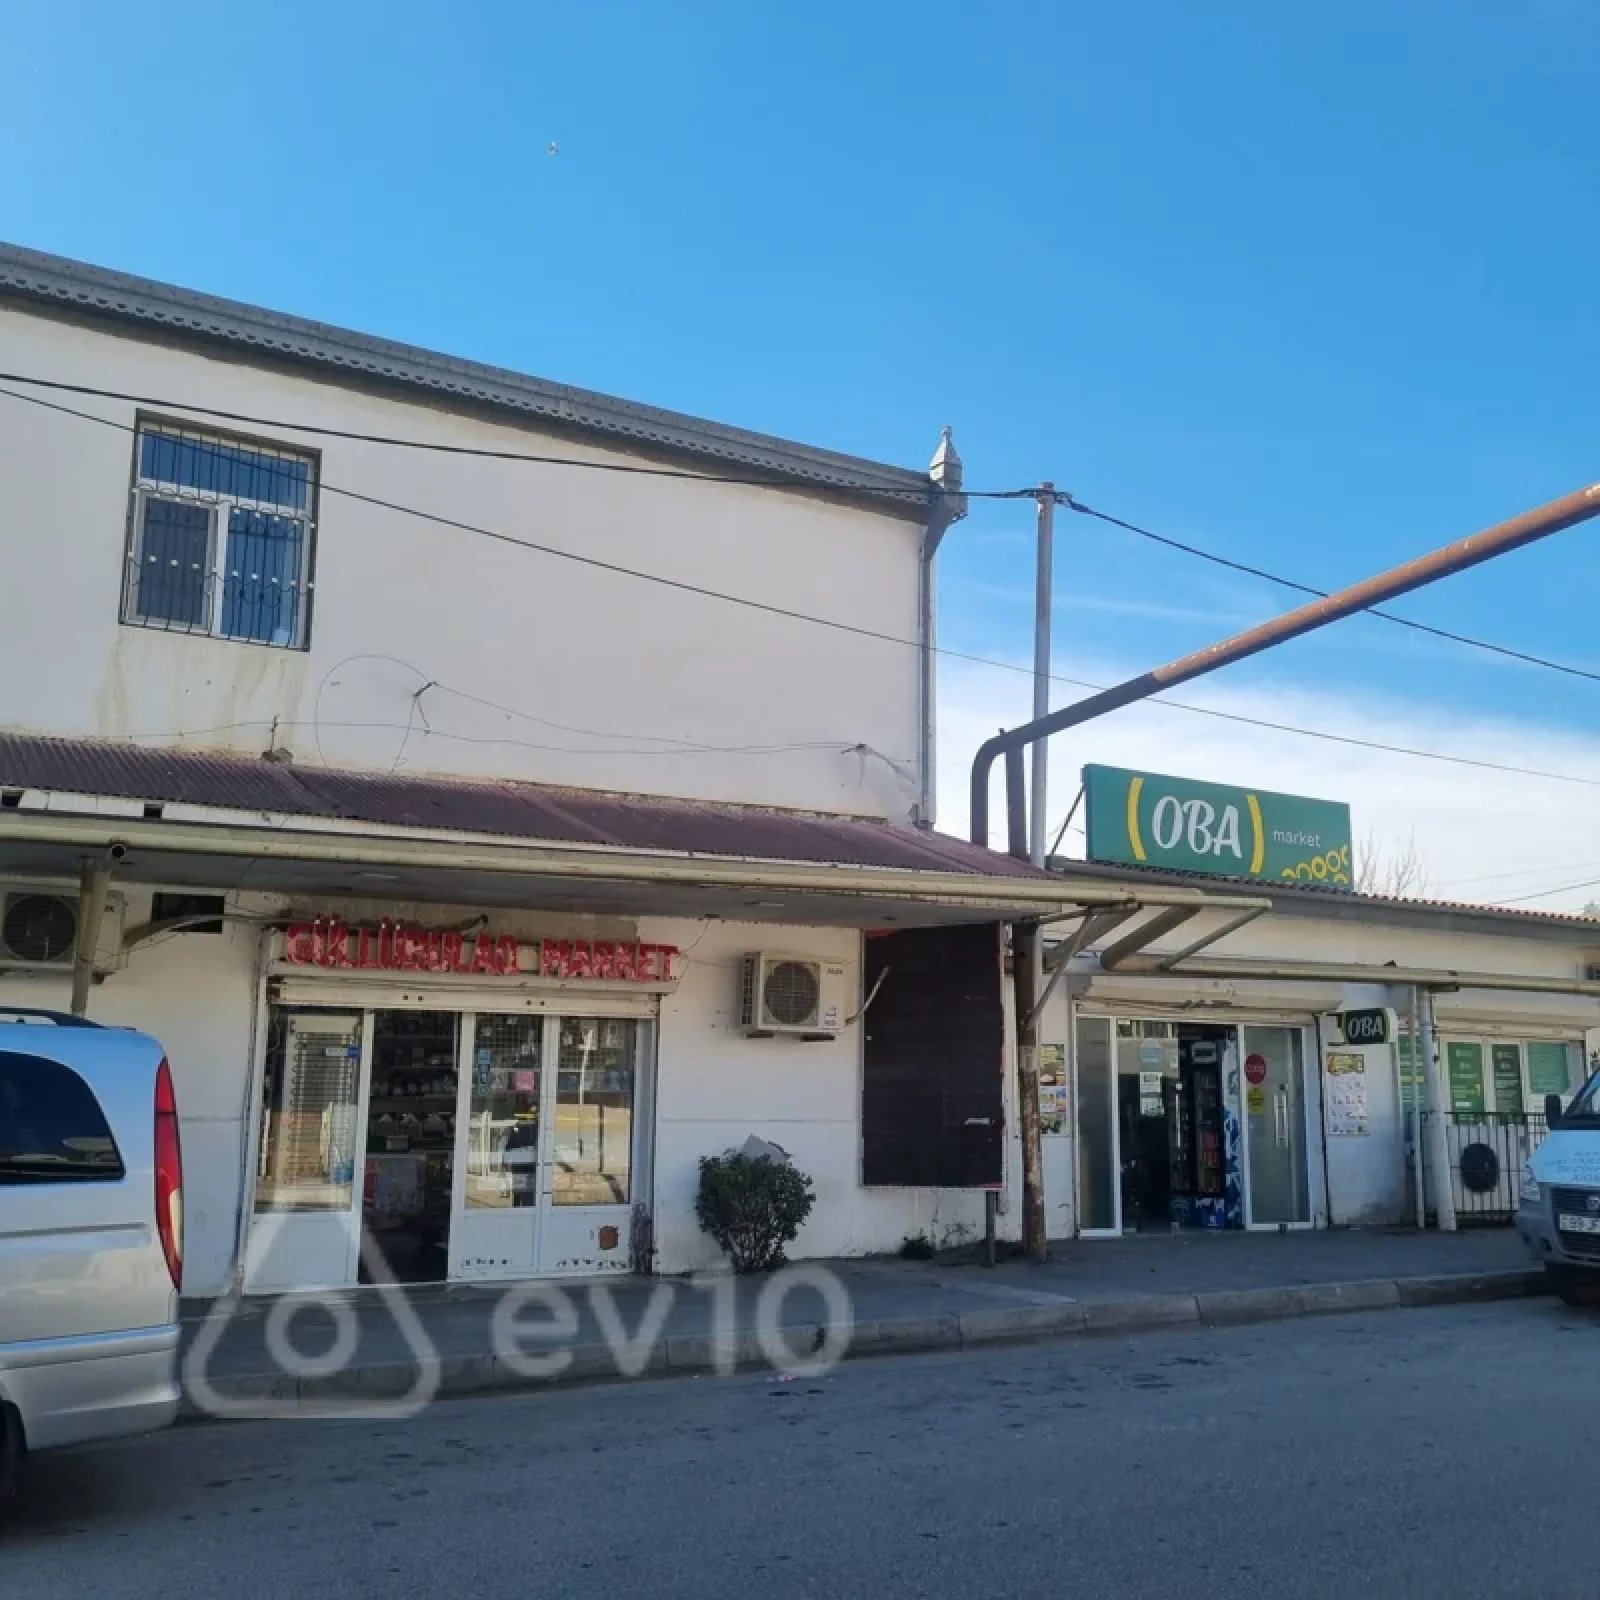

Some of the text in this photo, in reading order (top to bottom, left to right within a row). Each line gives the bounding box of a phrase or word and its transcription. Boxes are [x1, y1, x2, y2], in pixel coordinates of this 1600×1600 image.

[1152, 796, 1242, 858] OBA
[1273, 829, 1321, 848] market
[542, 939, 679, 982] MARKET
[1348, 1016, 1384, 1038] OBA
